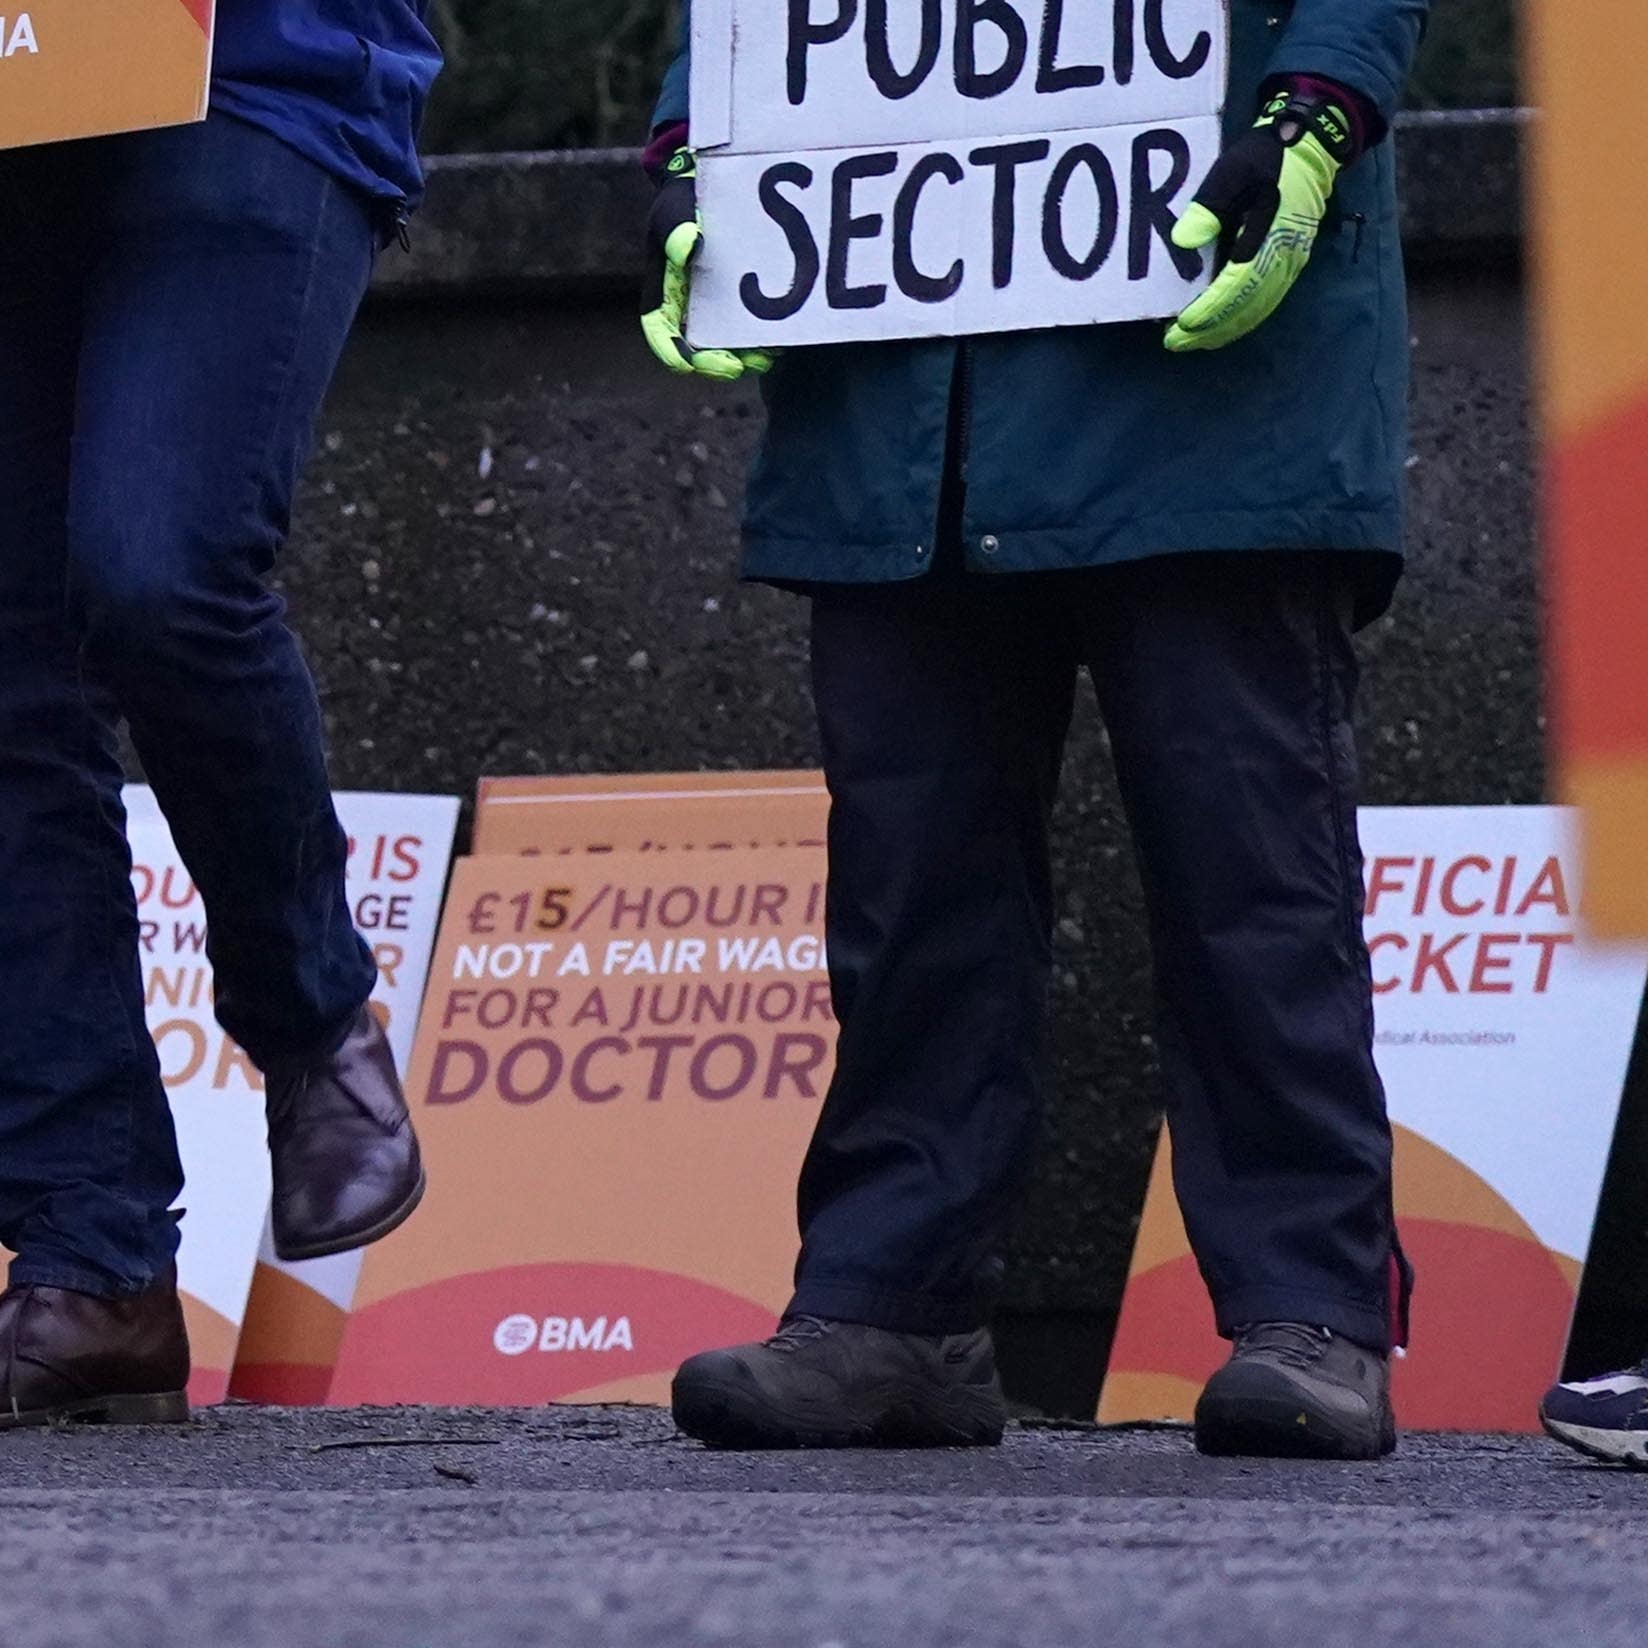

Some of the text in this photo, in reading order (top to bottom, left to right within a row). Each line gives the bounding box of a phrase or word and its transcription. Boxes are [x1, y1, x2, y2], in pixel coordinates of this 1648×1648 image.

[740, 128, 1203, 321] SECTOR
[371, 835, 423, 884] IS
[468, 883, 789, 934] £15/HOUR
[1363, 856, 1570, 917] FICIA
[452, 942, 552, 980] NOT
[558, 942, 590, 977] A
[604, 938, 705, 975] FAIR
[1367, 933, 1575, 994] CKET
[442, 987, 560, 1030] FOR
[572, 986, 609, 1027] A
[424, 1032, 827, 1106] DOCTOR
[539, 1314, 633, 1353] BMA
